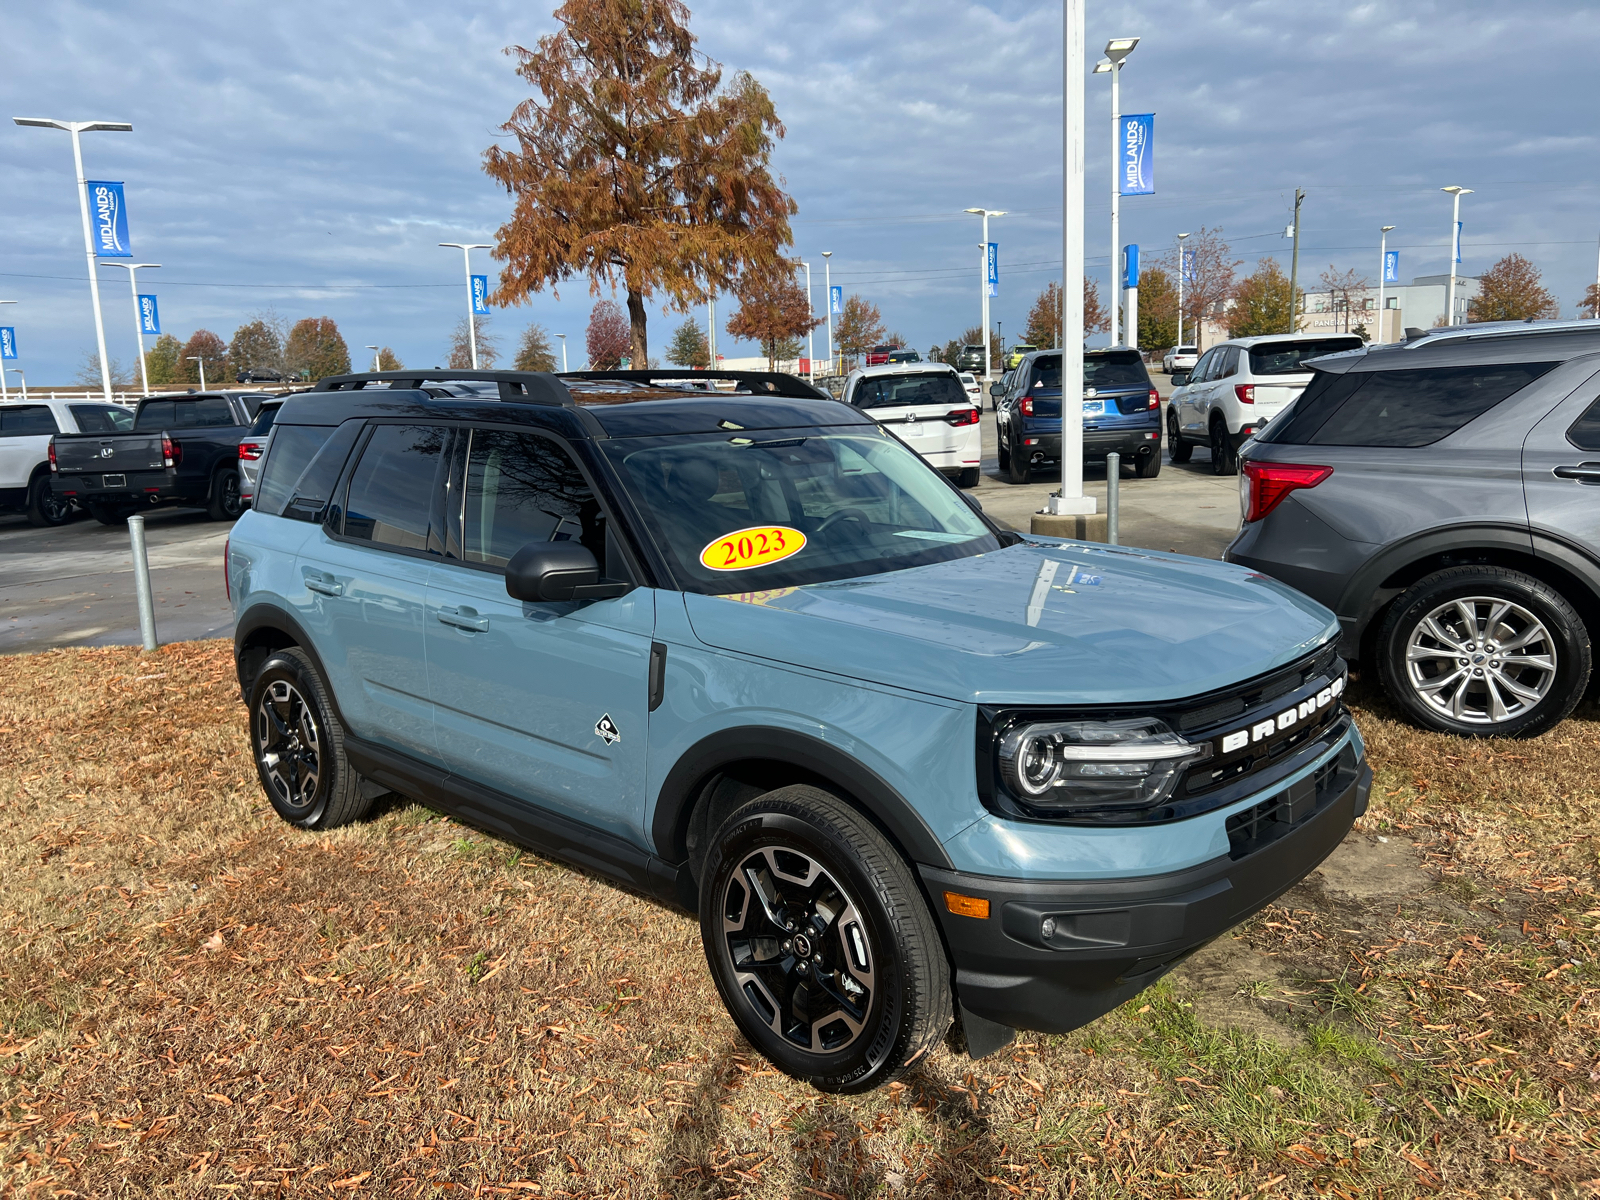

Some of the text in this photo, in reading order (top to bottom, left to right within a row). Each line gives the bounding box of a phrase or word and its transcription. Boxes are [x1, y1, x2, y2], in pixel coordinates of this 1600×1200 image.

[1127, 121, 1138, 188] MIDLANDS
[95, 187, 114, 250] MIDLANDS
[473, 278, 482, 311] MIDLANDS
[141, 297, 152, 331] MIDLANDS
[1314, 319, 1345, 327] PANERA
[720, 530, 786, 566] 2023
[1222, 677, 1343, 753] BRONCO
[723, 824, 747, 846] PRIMACY
[868, 994, 894, 1063] MICHELIN
[842, 1065, 866, 1083] 225/60
